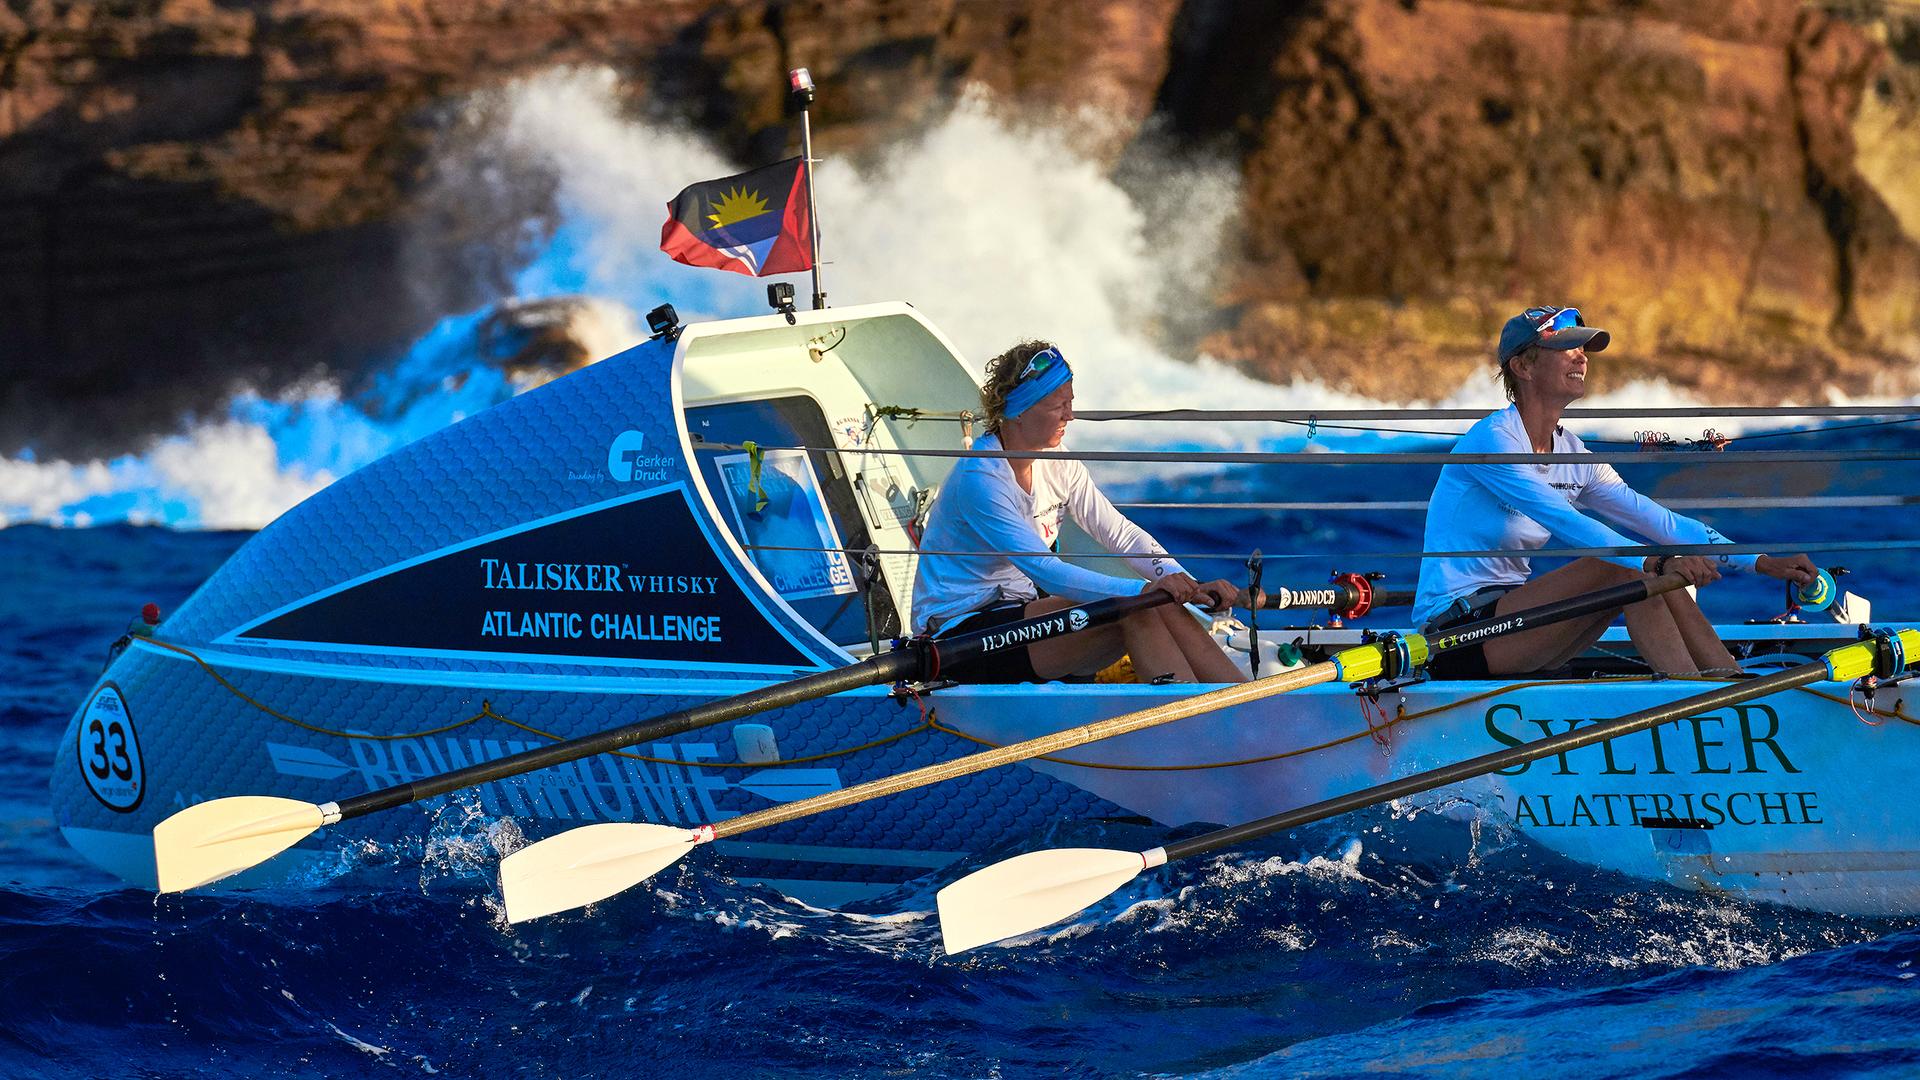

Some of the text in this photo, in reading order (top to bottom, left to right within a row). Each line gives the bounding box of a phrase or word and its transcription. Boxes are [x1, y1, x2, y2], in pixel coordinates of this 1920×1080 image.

[636, 454, 674, 467] Gerken
[634, 469, 667, 481] Druck
[480, 558, 719, 594] TALISKER WHISKY
[774, 566, 850, 592] CHALLENGE
[1291, 589, 1336, 606] RANNOCH
[481, 611, 722, 642] ATLANTIC CHALLENGE
[982, 617, 1065, 653] RANNOCH
[1460, 617, 1524, 643] concept 2
[89, 719, 133, 781] 33
[1497, 791, 1824, 828] ALATERISCHE
